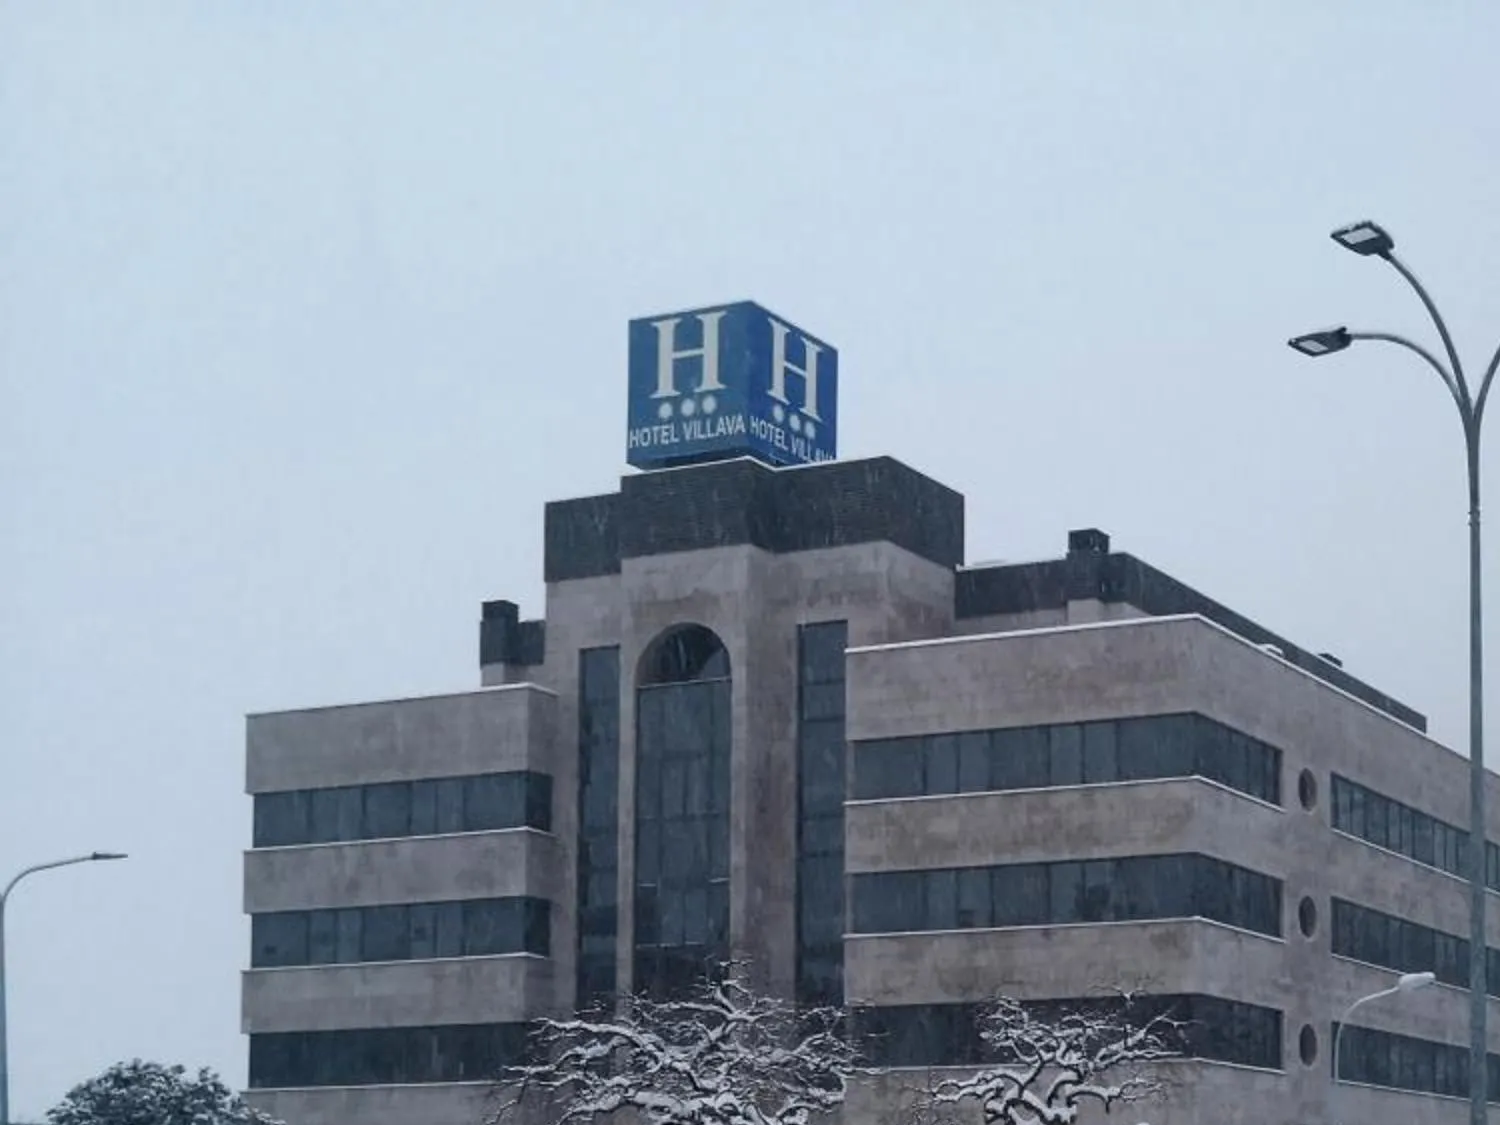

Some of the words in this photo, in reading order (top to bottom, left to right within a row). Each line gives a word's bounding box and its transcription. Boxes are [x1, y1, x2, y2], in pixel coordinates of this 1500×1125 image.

[649, 310, 727, 398] H
[766, 317, 824, 422] H
[629, 422, 680, 449] HOTEL
[682, 413, 747, 442] VILLAVA
[749, 415, 789, 451] HOTEL
